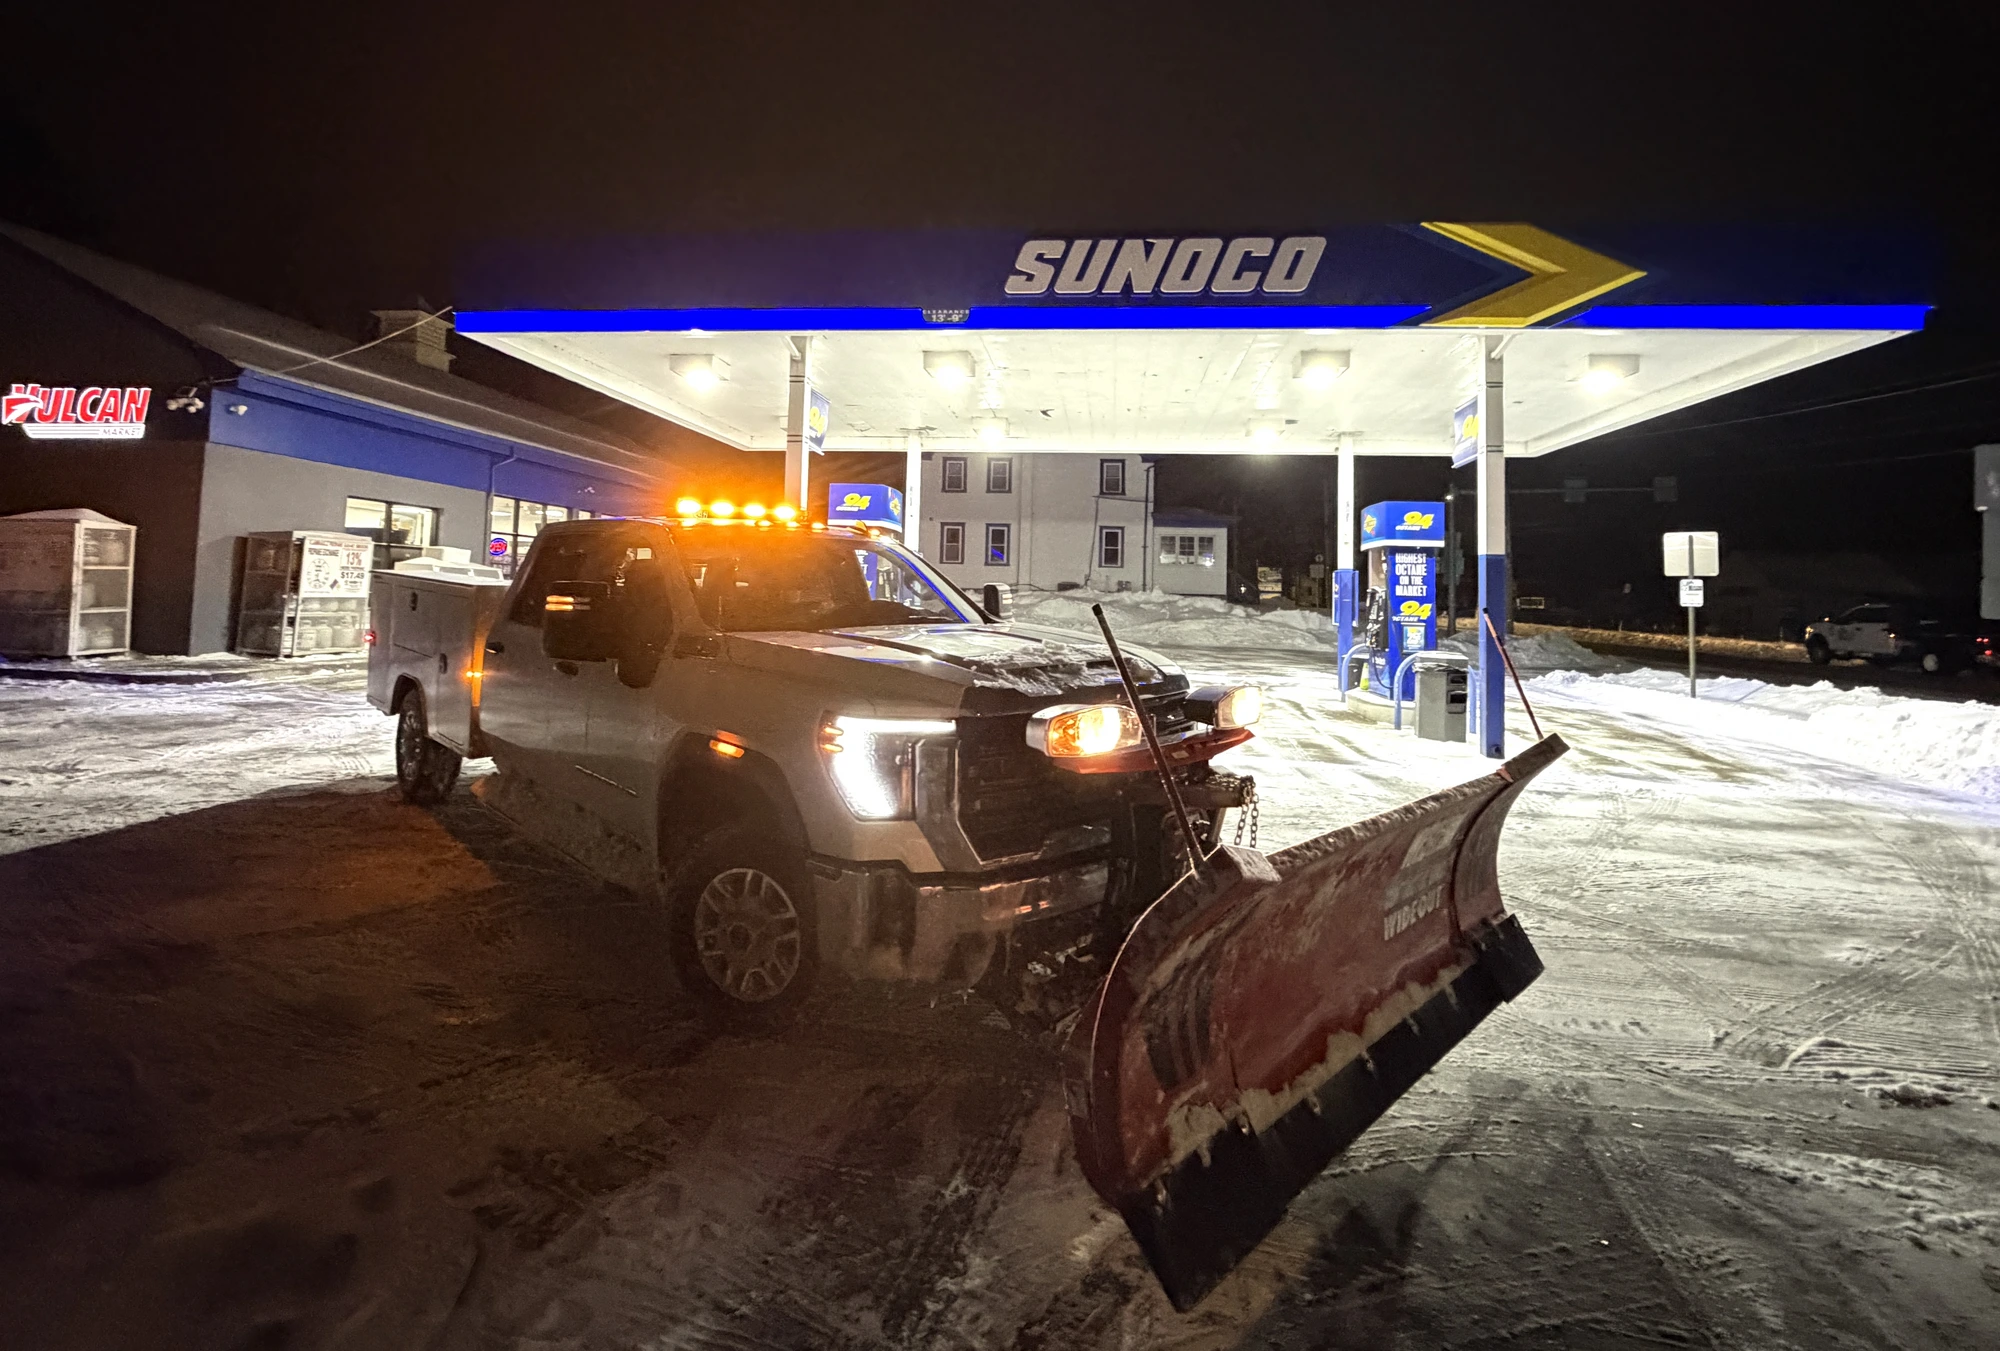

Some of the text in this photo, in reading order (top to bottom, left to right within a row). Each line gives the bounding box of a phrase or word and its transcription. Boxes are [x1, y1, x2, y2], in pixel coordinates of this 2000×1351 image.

[1004, 236, 1327, 295] SUNOCO
[102, 428, 142, 436] MARKET
[843, 493, 871, 510] 94
[1404, 511, 1434, 529] 94
[346, 551, 363, 567] 13%
[1395, 553, 1427, 563] HIGHEST
[1395, 564, 1428, 576] OCTANE
[1399, 575, 1424, 585] ON THE
[1395, 585, 1428, 597] MARKET
[1400, 600, 1432, 620] 94
[1383, 884, 1444, 941] WIDEOUT
